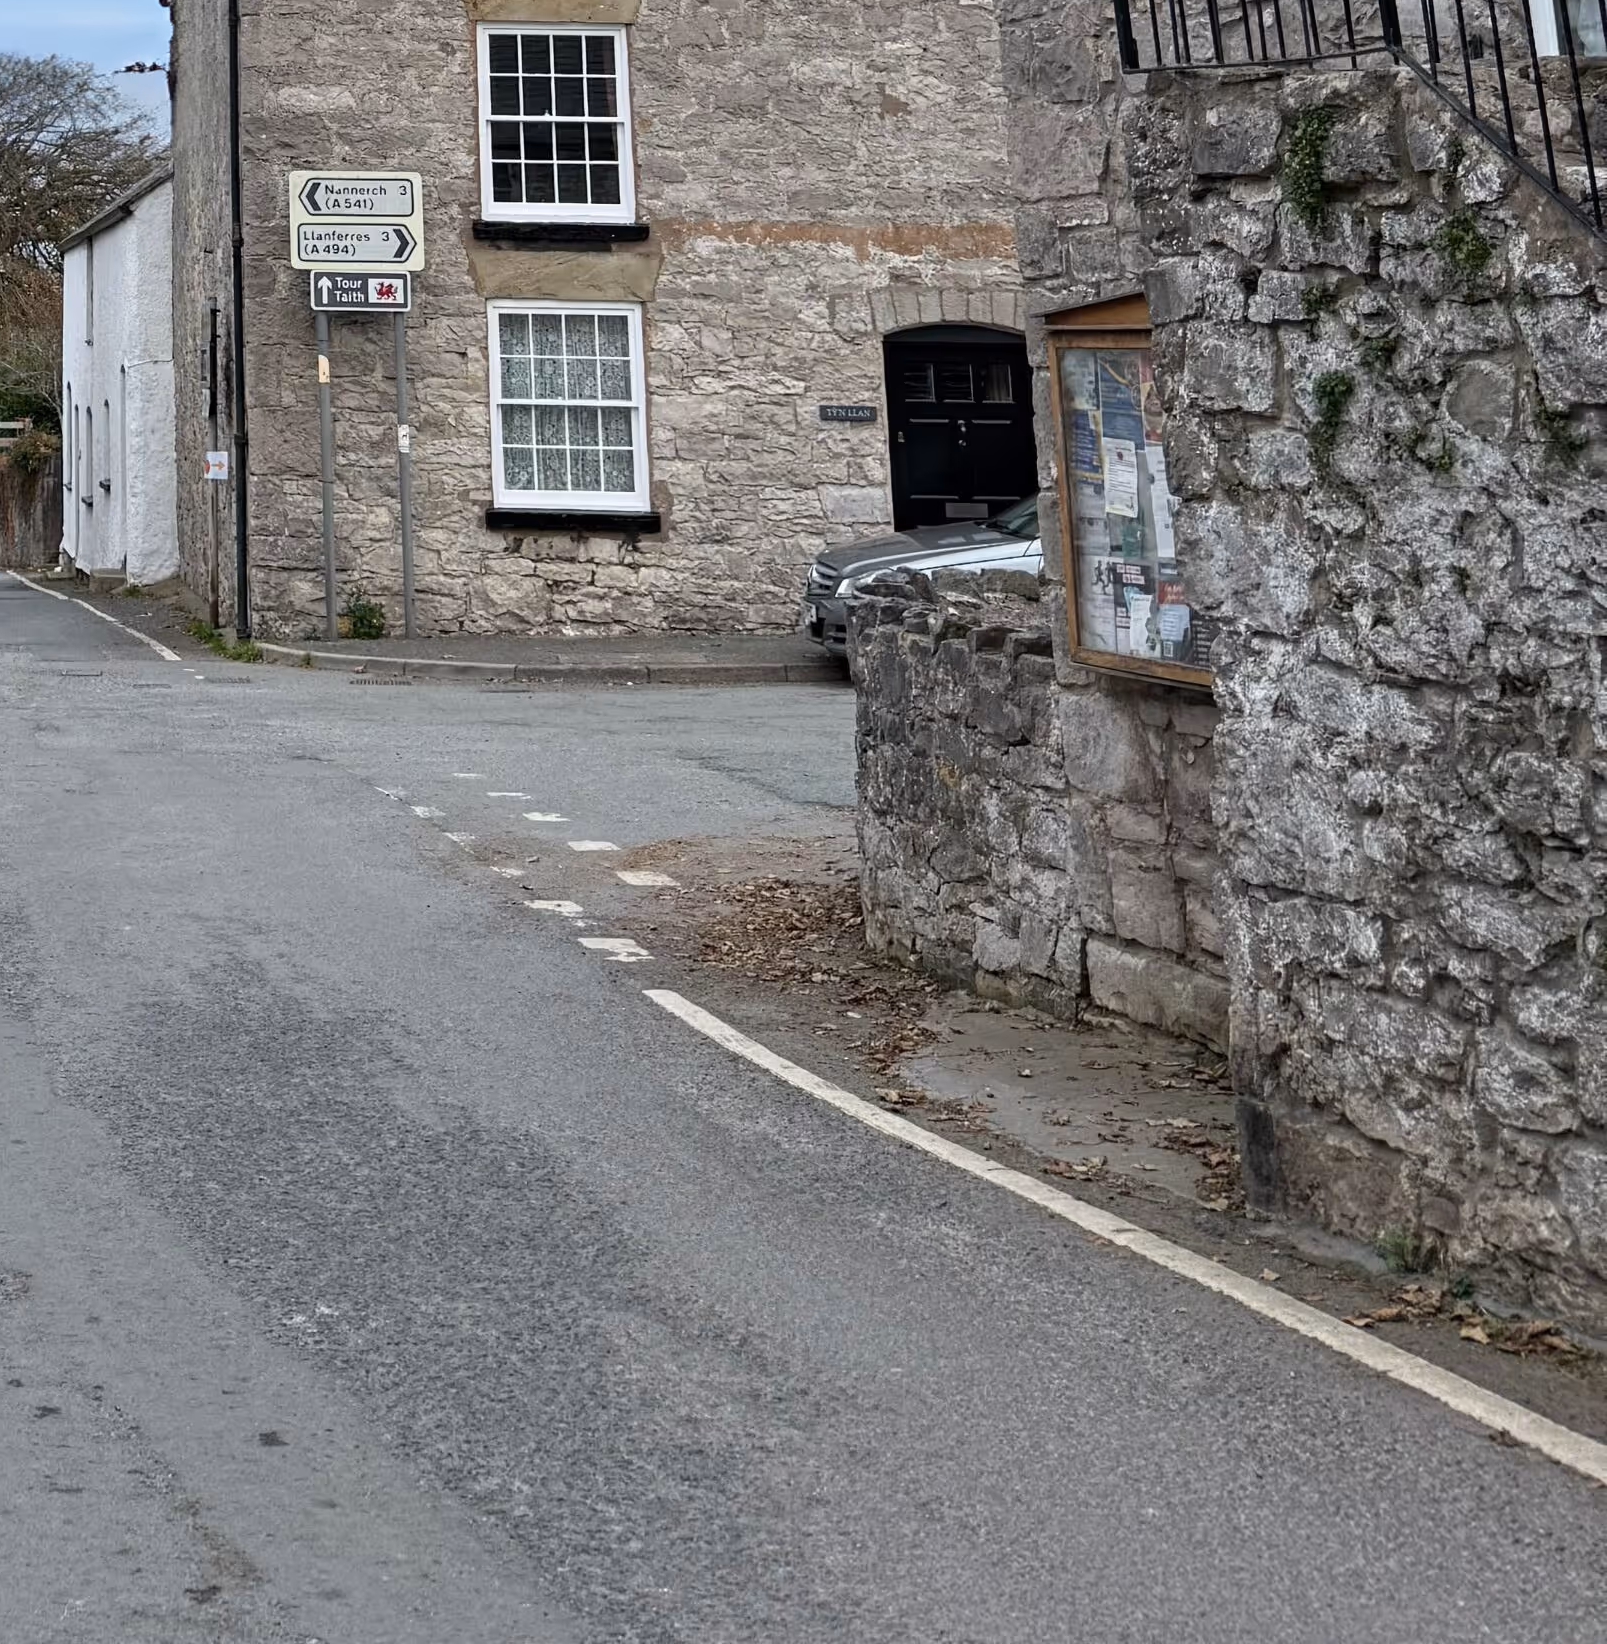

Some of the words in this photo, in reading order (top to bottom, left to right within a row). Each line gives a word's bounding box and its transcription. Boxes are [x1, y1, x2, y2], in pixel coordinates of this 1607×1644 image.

[324, 184, 387, 196] Nannerch
[399, 185, 408, 196] 3
[303, 230, 371, 242] Llanferres
[381, 231, 390, 242] 3
[335, 277, 362, 288] Tour
[334, 290, 365, 303] Taith
[848, 408, 870, 417] LLAN
